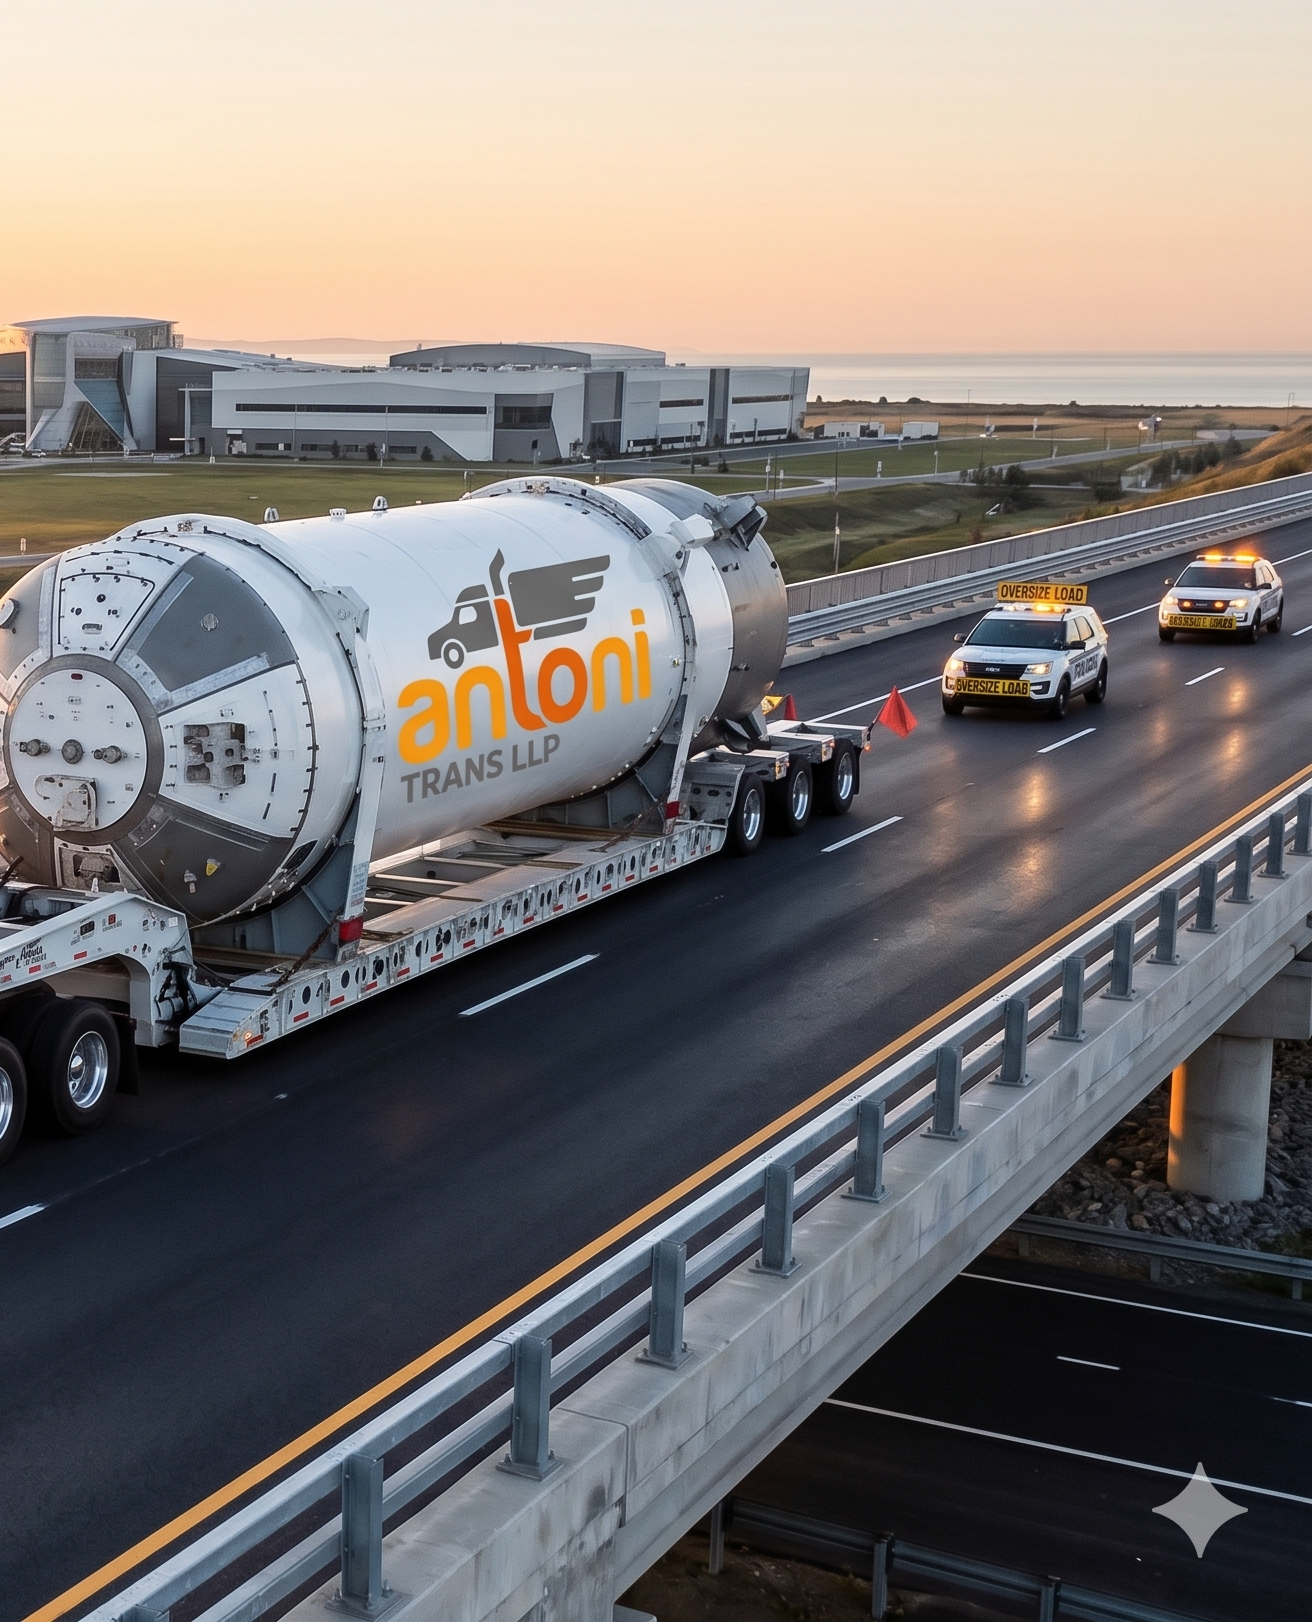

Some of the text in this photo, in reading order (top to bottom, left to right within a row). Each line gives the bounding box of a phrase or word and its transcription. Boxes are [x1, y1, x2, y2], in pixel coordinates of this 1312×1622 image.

[1001, 585, 1083, 602] OVERSIZE LOAD
[397, 598, 652, 765] antoni
[400, 733, 561, 803] TRANS LLP
